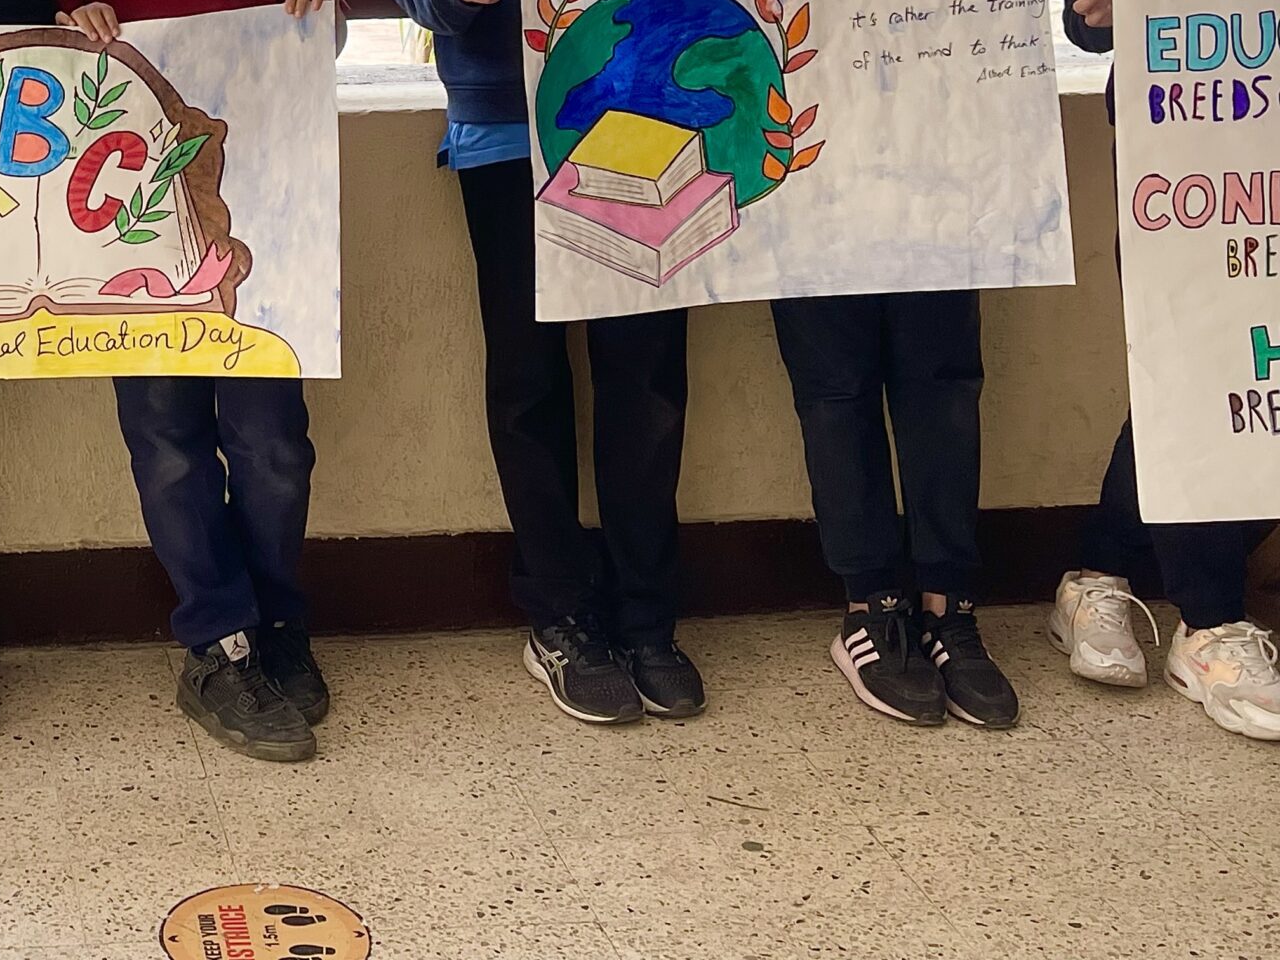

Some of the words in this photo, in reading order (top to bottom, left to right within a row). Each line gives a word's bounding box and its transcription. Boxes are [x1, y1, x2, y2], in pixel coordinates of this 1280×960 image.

[851, 11, 878, 30] it's
[888, 5, 935, 26] rather
[1146, 10, 1280, 73] EDU
[852, 50, 870, 71] of
[880, 49, 904, 66] the
[917, 42, 953, 60] mind
[970, 39, 987, 57] to
[1148, 75, 1273, 125] BREEDS
[36, 319, 174, 356] Education
[180, 316, 256, 370] Day
[197, 914, 219, 938] YOUR
[218, 905, 255, 960] STANCE
